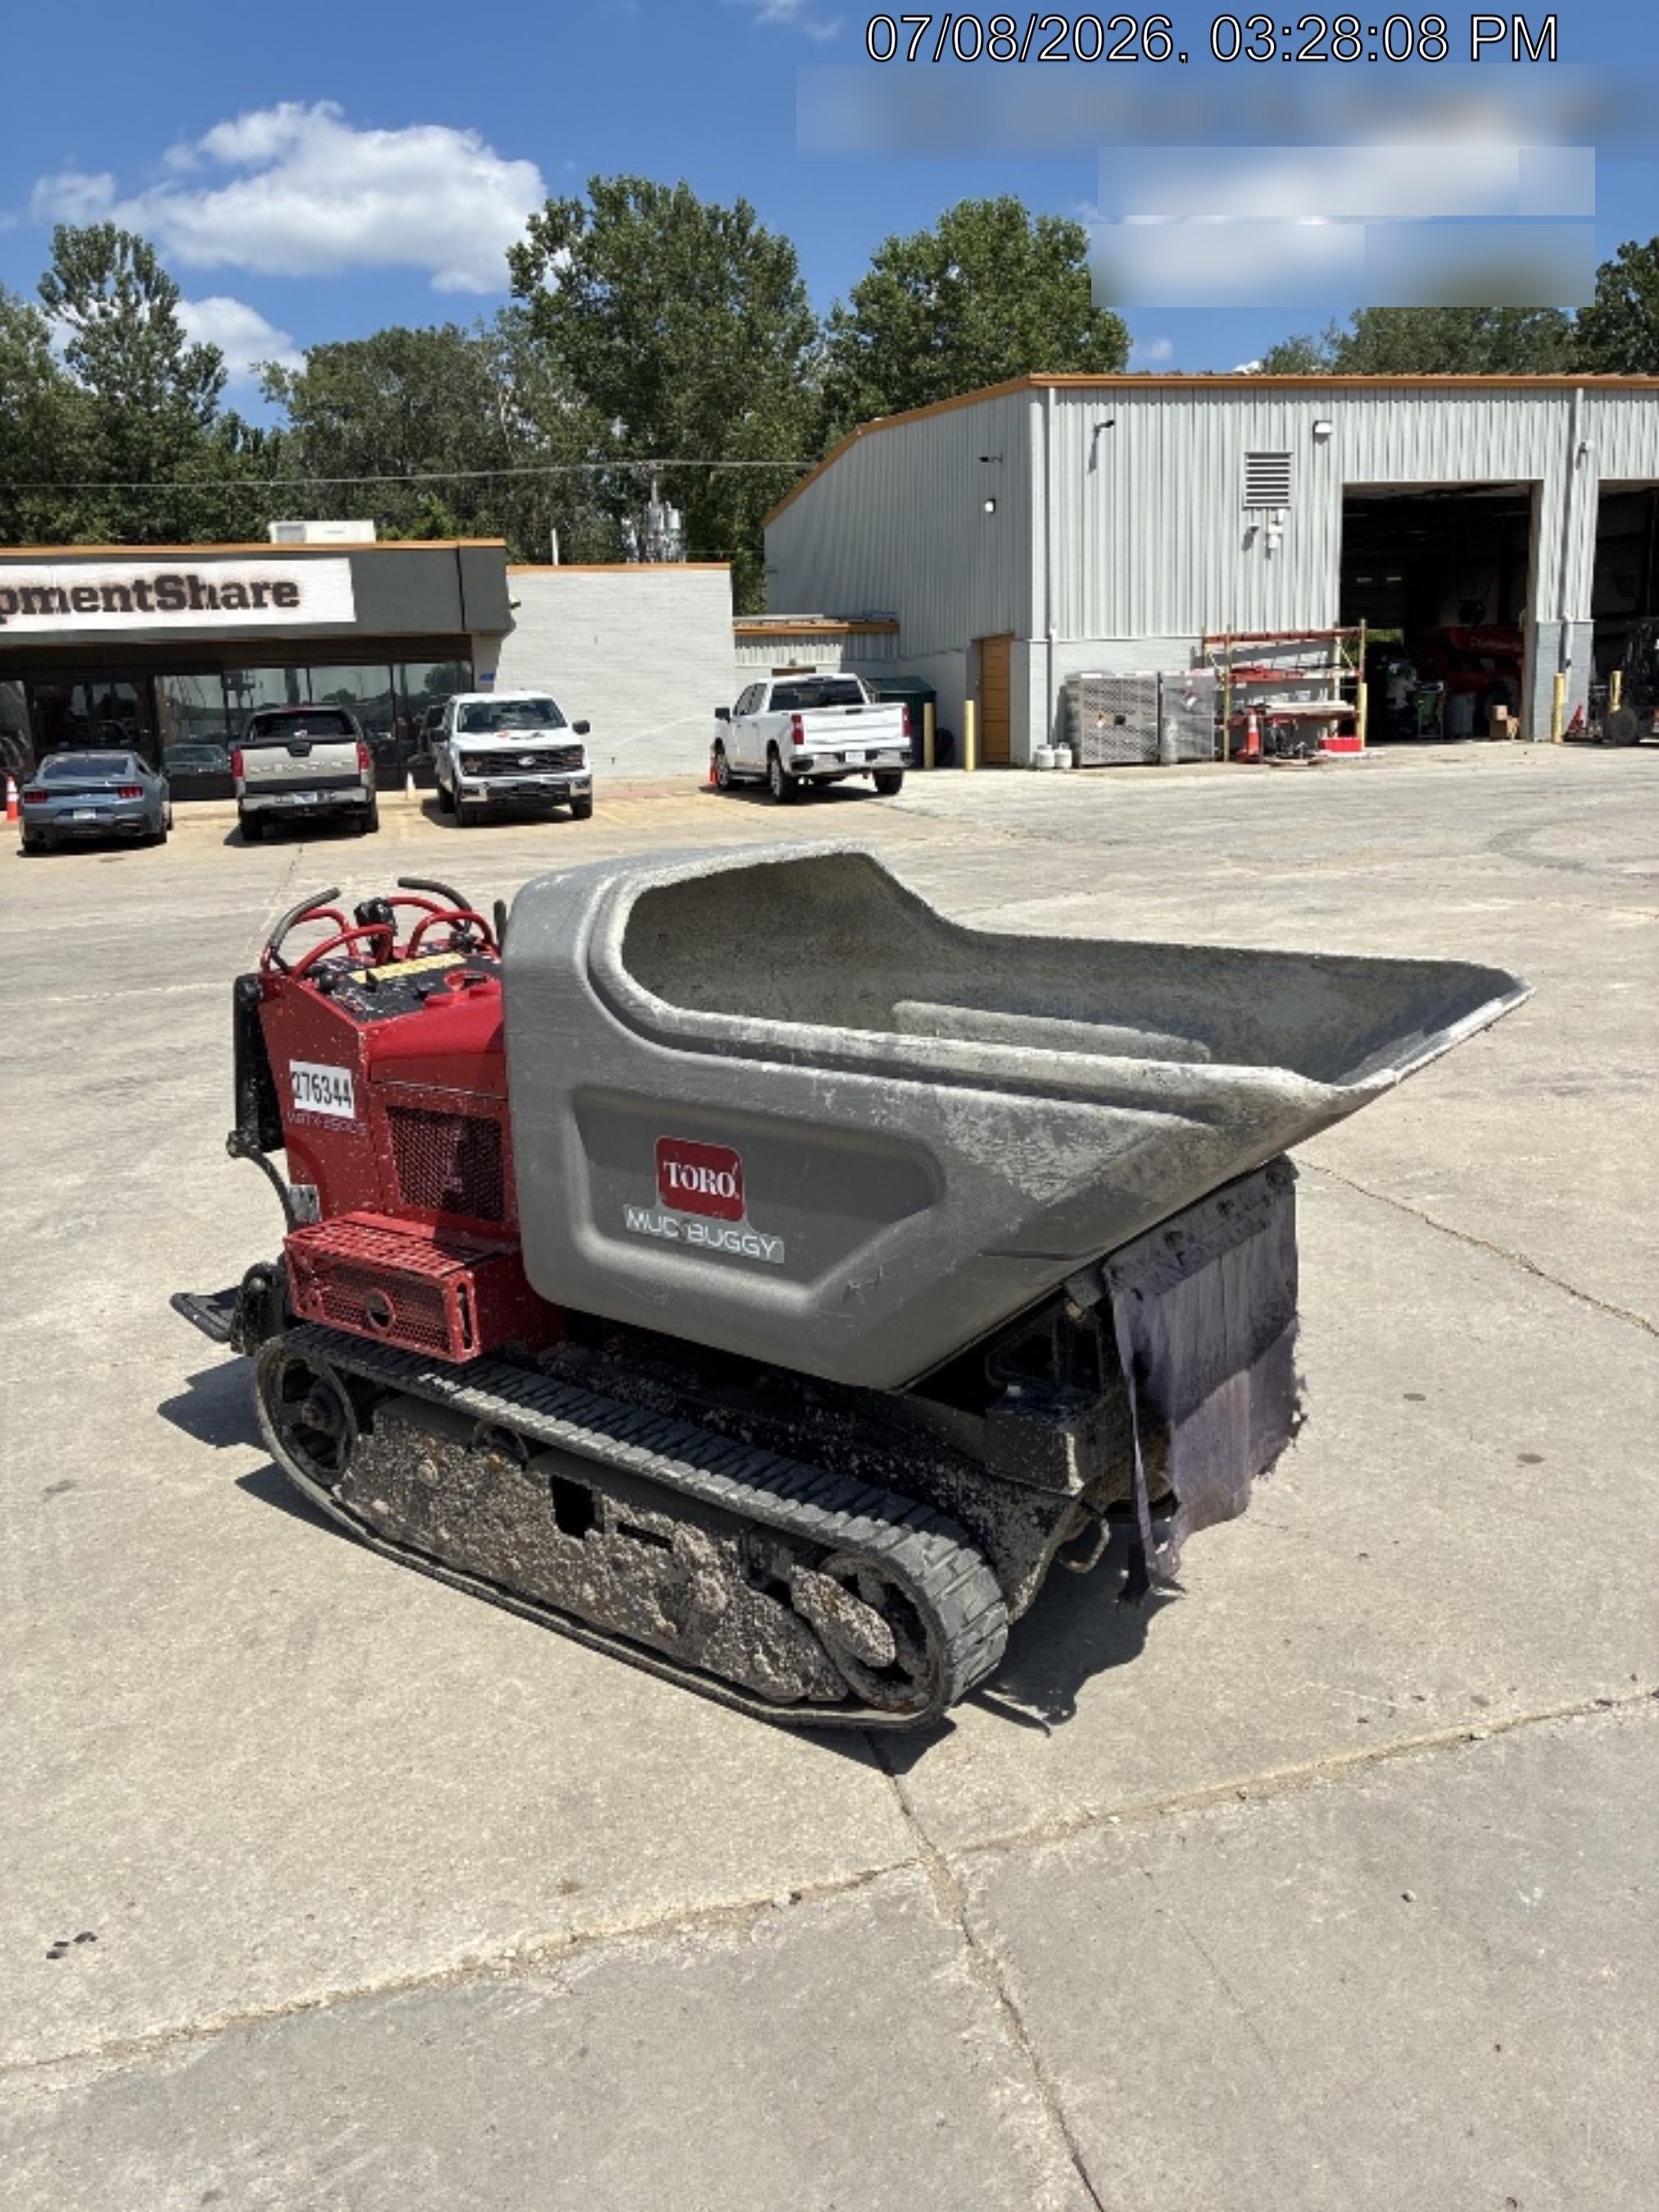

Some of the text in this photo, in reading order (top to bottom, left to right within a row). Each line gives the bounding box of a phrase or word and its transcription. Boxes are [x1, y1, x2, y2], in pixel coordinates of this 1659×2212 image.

[291, 1072, 351, 1108] 276344
[663, 1161, 738, 1199] TORO
[687, 1223, 778, 1259] BUGGY
